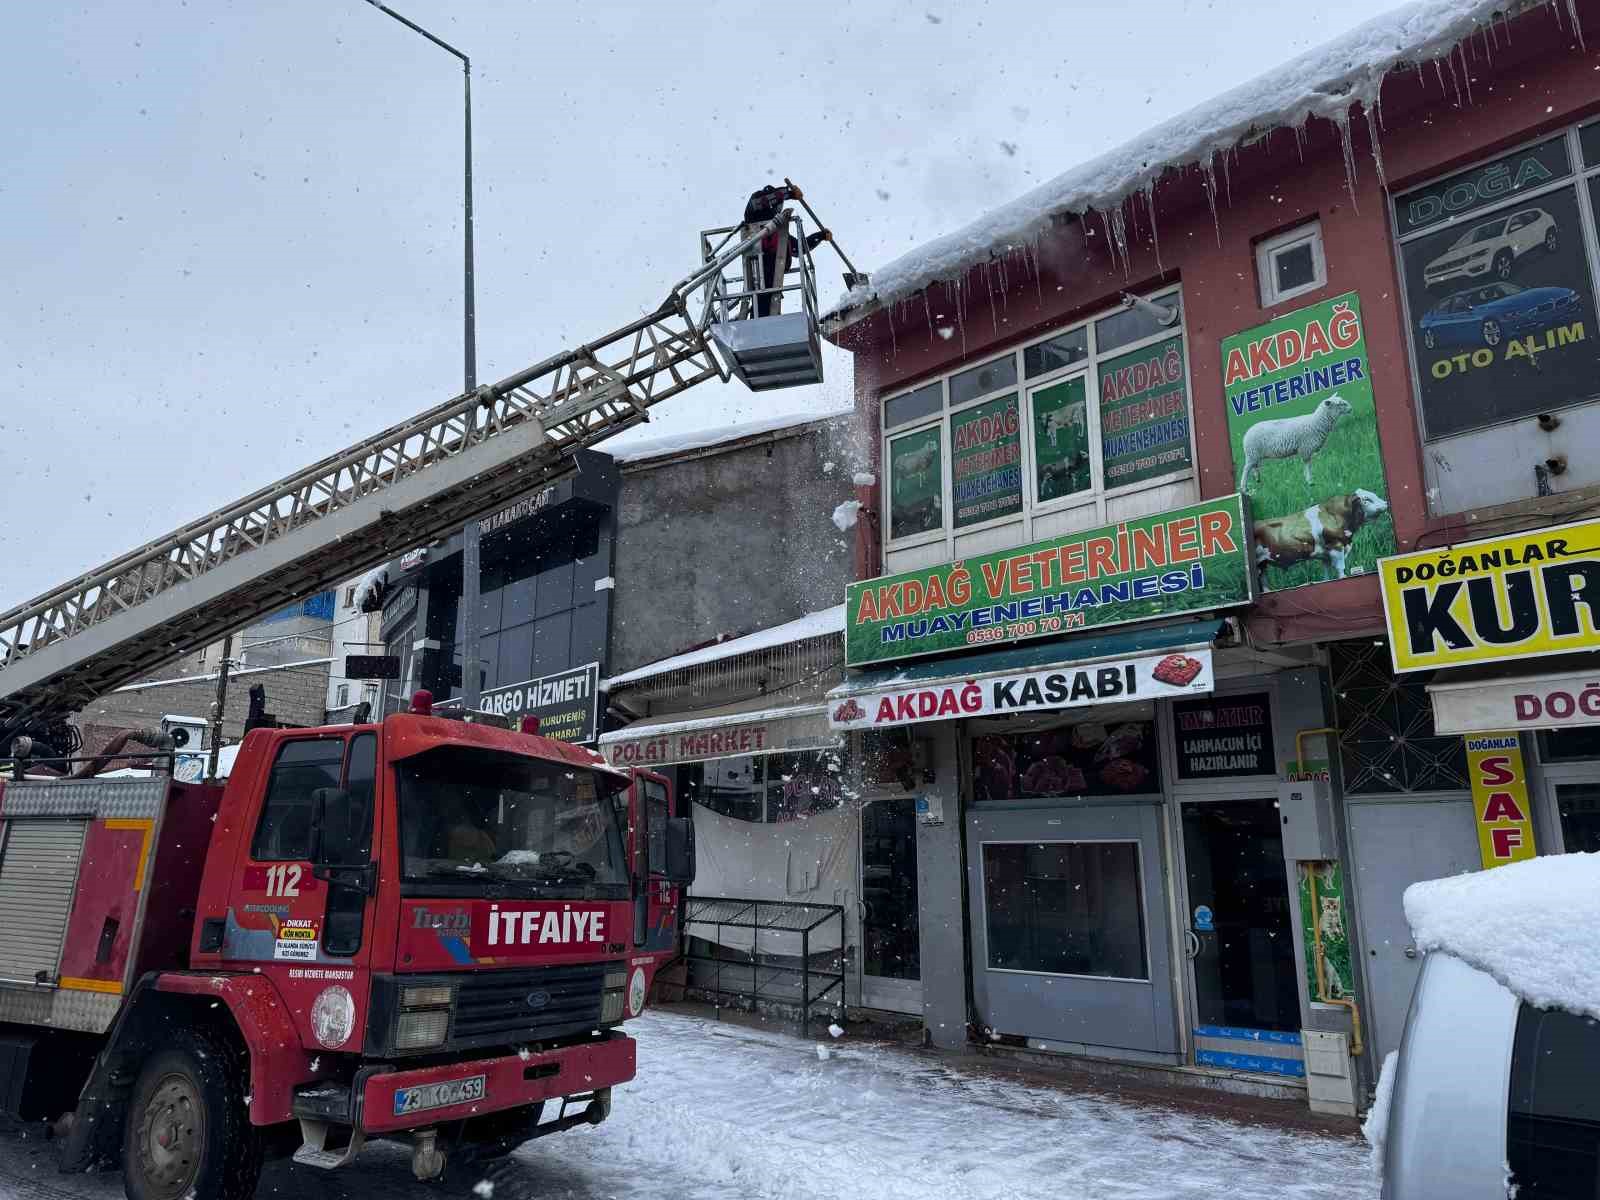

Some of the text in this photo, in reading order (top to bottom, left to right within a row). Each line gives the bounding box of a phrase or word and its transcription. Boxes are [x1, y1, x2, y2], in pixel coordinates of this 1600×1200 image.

[1409, 157, 1552, 225] DOĞA
[1224, 301, 1361, 386] AKDAĞ
[1431, 321, 1585, 379] OTO ALIM
[1102, 344, 1182, 404] AKDAĞ
[1231, 357, 1366, 416] VETERİNER
[954, 401, 1019, 453] AKDAĞ
[856, 511, 1239, 625] AKDAĞ VETERİNER
[1395, 539, 1568, 585] DOĞANLAR
[880, 562, 1206, 644] MUAYENEHANESİ
[1402, 559, 1600, 656] KUR
[966, 612, 1086, 645] 0536 700 70 71
[527, 669, 590, 709] HİZMETİ
[875, 664, 1137, 724] AKDAĞ KASABI
[612, 727, 768, 763] POLAT MARKET
[1184, 732, 1263, 753] LAHMACUN İÇİ
[1190, 754, 1258, 771] HAZIRLANIR
[1467, 736, 1518, 752] DOĞANLAR
[266, 864, 302, 897] 112
[287, 919, 312, 928] DİKKAT
[411, 904, 605, 945] Turb İTFAİYE
